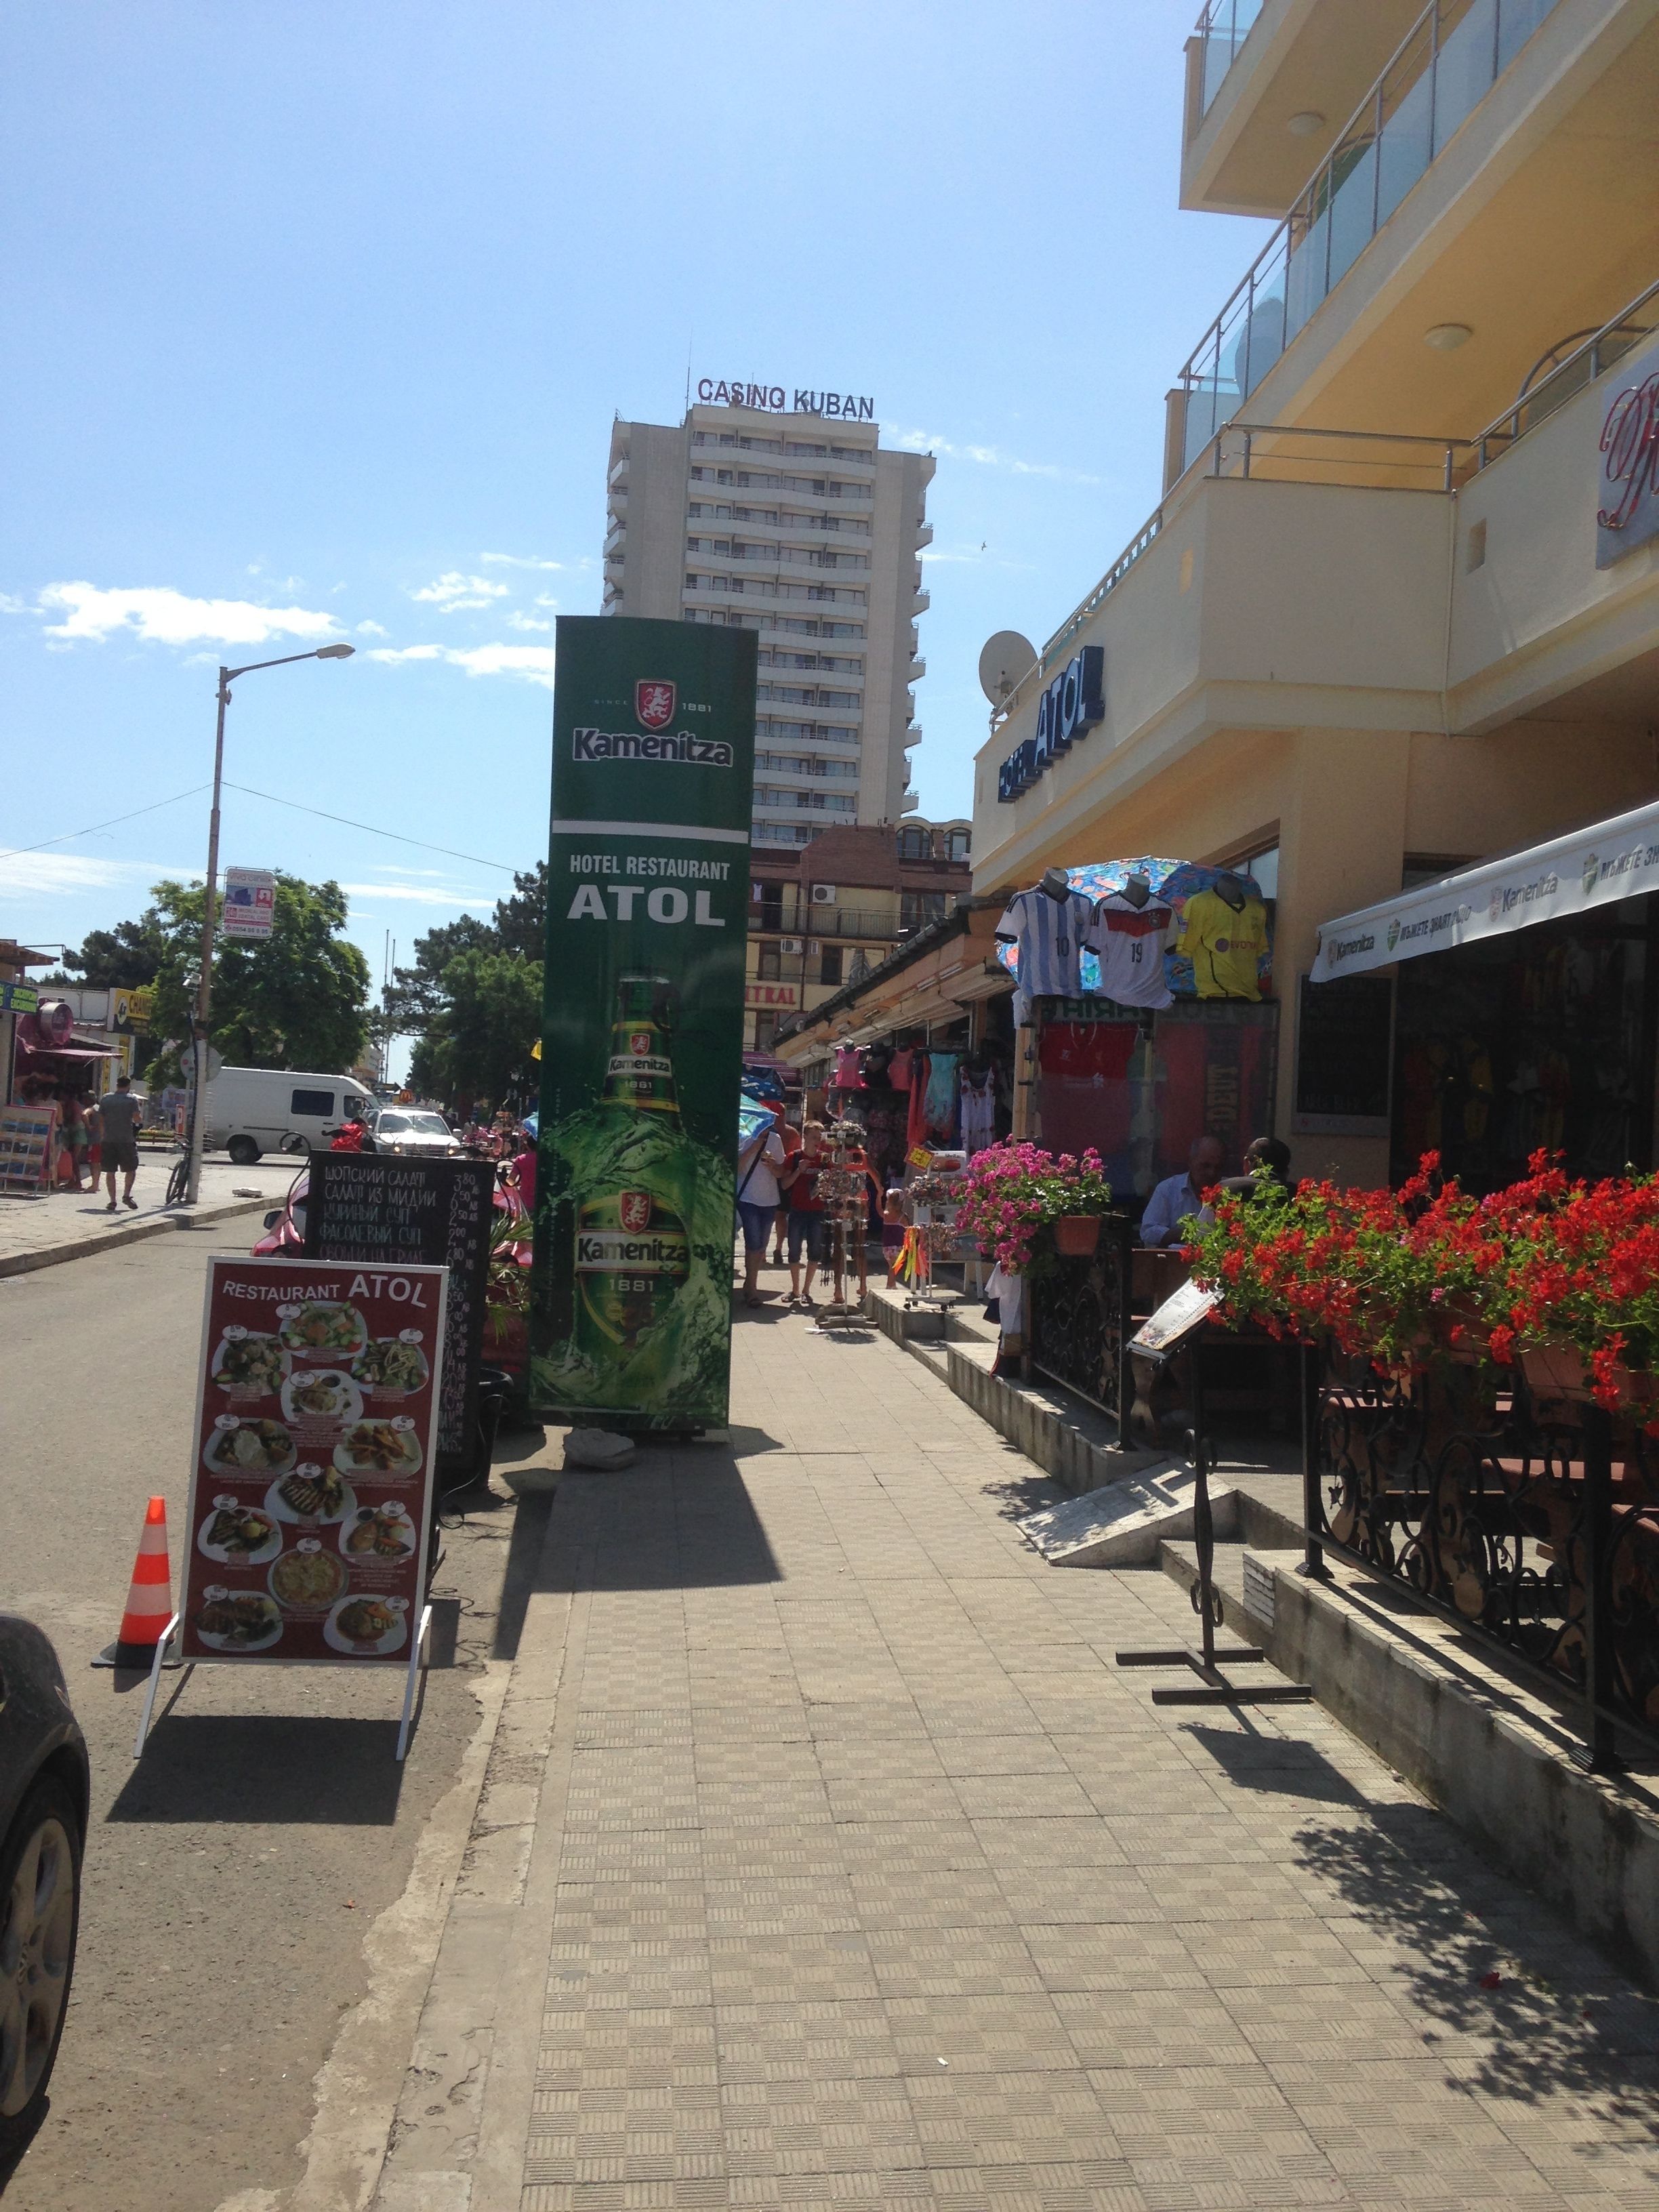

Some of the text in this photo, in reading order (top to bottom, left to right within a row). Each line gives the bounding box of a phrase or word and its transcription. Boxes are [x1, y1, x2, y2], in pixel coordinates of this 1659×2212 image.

[698, 378, 874, 419] CASINO KUBAN
[682, 702, 712, 713] 1881
[1034, 646, 1105, 770] ATOL
[574, 729, 733, 766] Kamenitza
[571, 855, 731, 881] HOTEL RESTAURANT
[1502, 872, 1558, 912] Kamenitza
[567, 884, 726, 926] ATOL
[1056, 937, 1069, 957] 10
[1130, 943, 1143, 963] 19
[610, 1058, 670, 1072] Kamenitza
[625, 1080, 652, 1089] 1881
[325, 1165, 385, 1185] ШОПСКИЙ
[368, 1187, 383, 1204] ИЗ
[388, 1187, 437, 1210] МИДИИ
[398, 1227, 422, 1246] СУП
[578, 1237, 690, 1263] Kamenitza
[222, 1280, 340, 1301] RESTAURANT
[348, 1273, 428, 1309] ATOL
[610, 1279, 654, 1292] 1881
